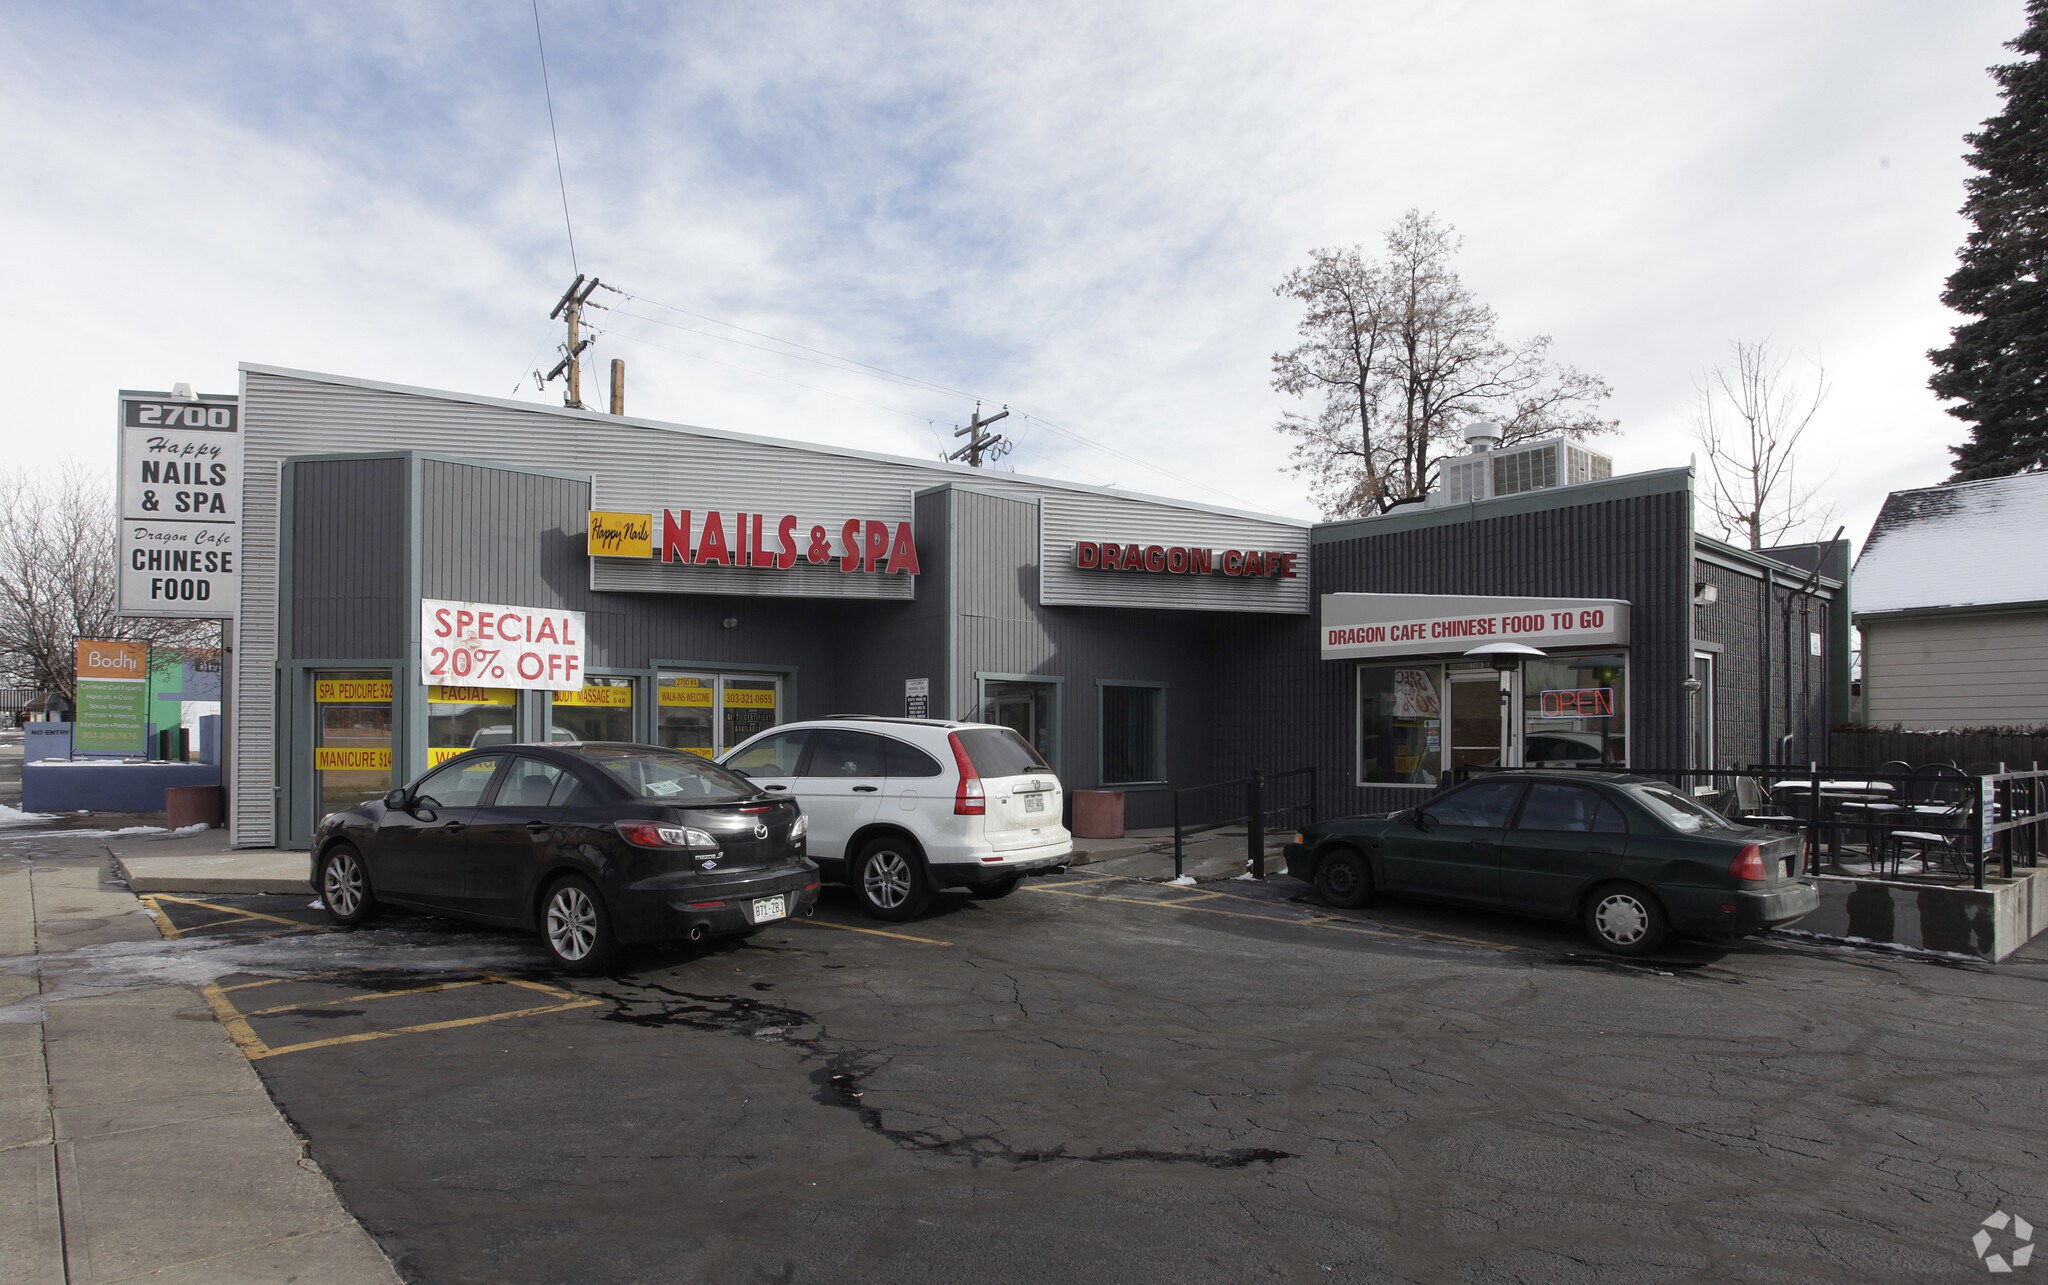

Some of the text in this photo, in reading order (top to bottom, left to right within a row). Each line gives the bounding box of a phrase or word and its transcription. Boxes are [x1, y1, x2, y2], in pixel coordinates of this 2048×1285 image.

[139, 404, 230, 428] 2700
[146, 437, 222, 460] Happy
[141, 460, 227, 487] NAILS
[141, 489, 226, 514] & SPA
[134, 527, 231, 547] Dragon Cafe
[592, 517, 649, 552] Happy Nails
[661, 508, 921, 576] NAILS & SPA
[132, 548, 233, 574] CHINESE
[1076, 541, 1297, 579] DRAGON CAFE
[151, 577, 211, 601] FOOD
[434, 608, 576, 646] SPECIAL
[1328, 609, 1604, 646] DRAGON CAFE CHINESE FOOD TO GO
[88, 650, 137, 672] Bodhi
[429, 647, 579, 682] 20% OFF
[319, 683, 335, 699] SPA
[441, 686, 488, 702] FACIAL
[554, 690, 574, 702] BODY
[577, 689, 610, 704] MASSAGE
[686, 692, 710, 703] WELCOME
[1543, 689, 1612, 716] OPEN
[320, 751, 376, 768] MANICURE
